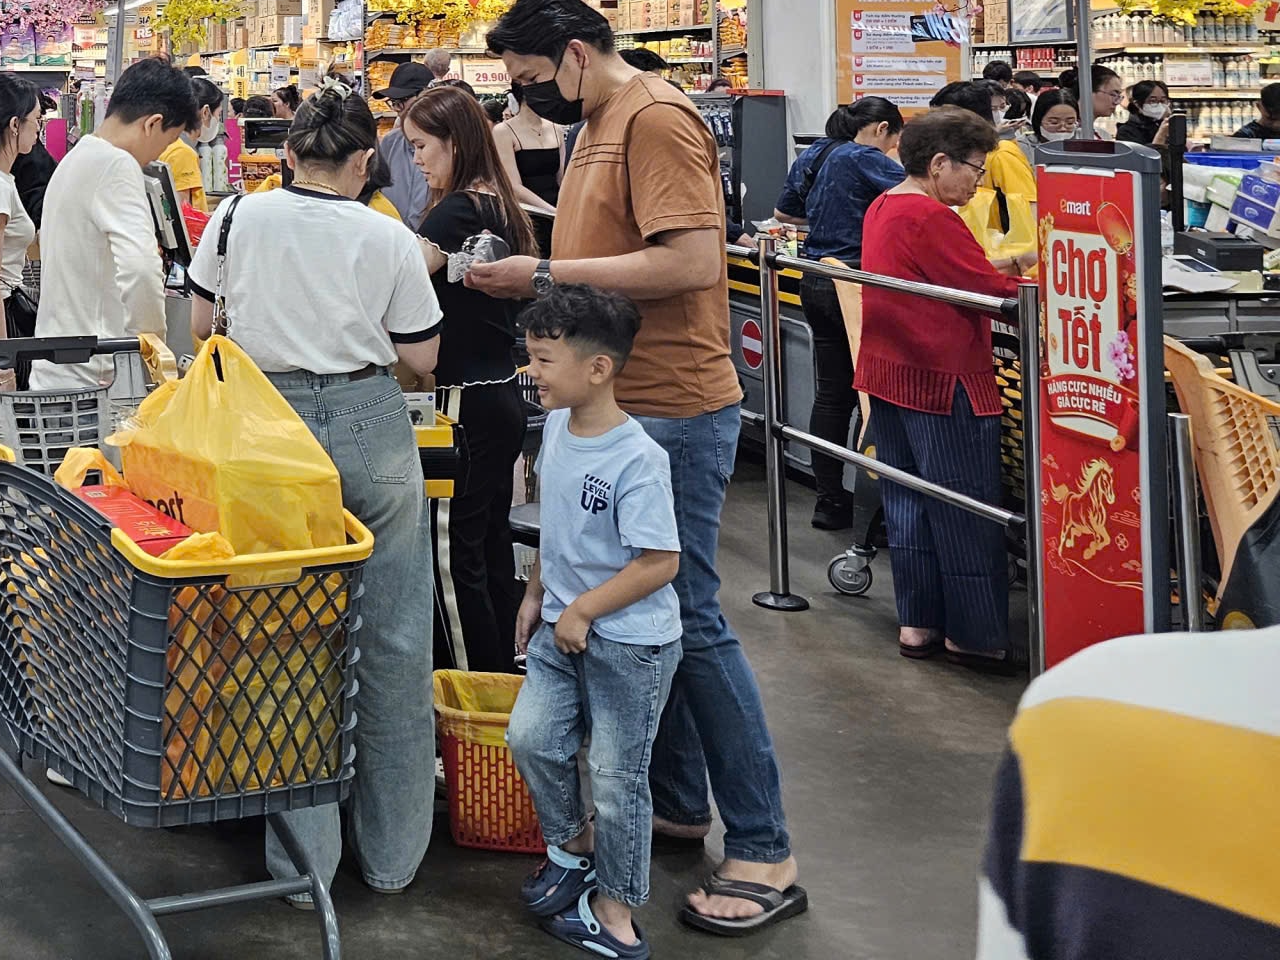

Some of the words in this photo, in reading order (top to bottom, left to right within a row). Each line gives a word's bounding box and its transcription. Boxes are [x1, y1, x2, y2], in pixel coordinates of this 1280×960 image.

[1059, 198, 1092, 217] emart
[1051, 238, 1108, 310] Chợ
[1058, 306, 1102, 373] Tết
[1047, 379, 1068, 395] HÀNG
[1089, 383, 1122, 405] NHIỀU
[1057, 393, 1072, 409] GIÁ
[1072, 394, 1091, 412] CỰC
[1092, 397, 1106, 415] RẺ
[583, 481, 609, 500] LEVEL
[580, 491, 608, 515] UP
